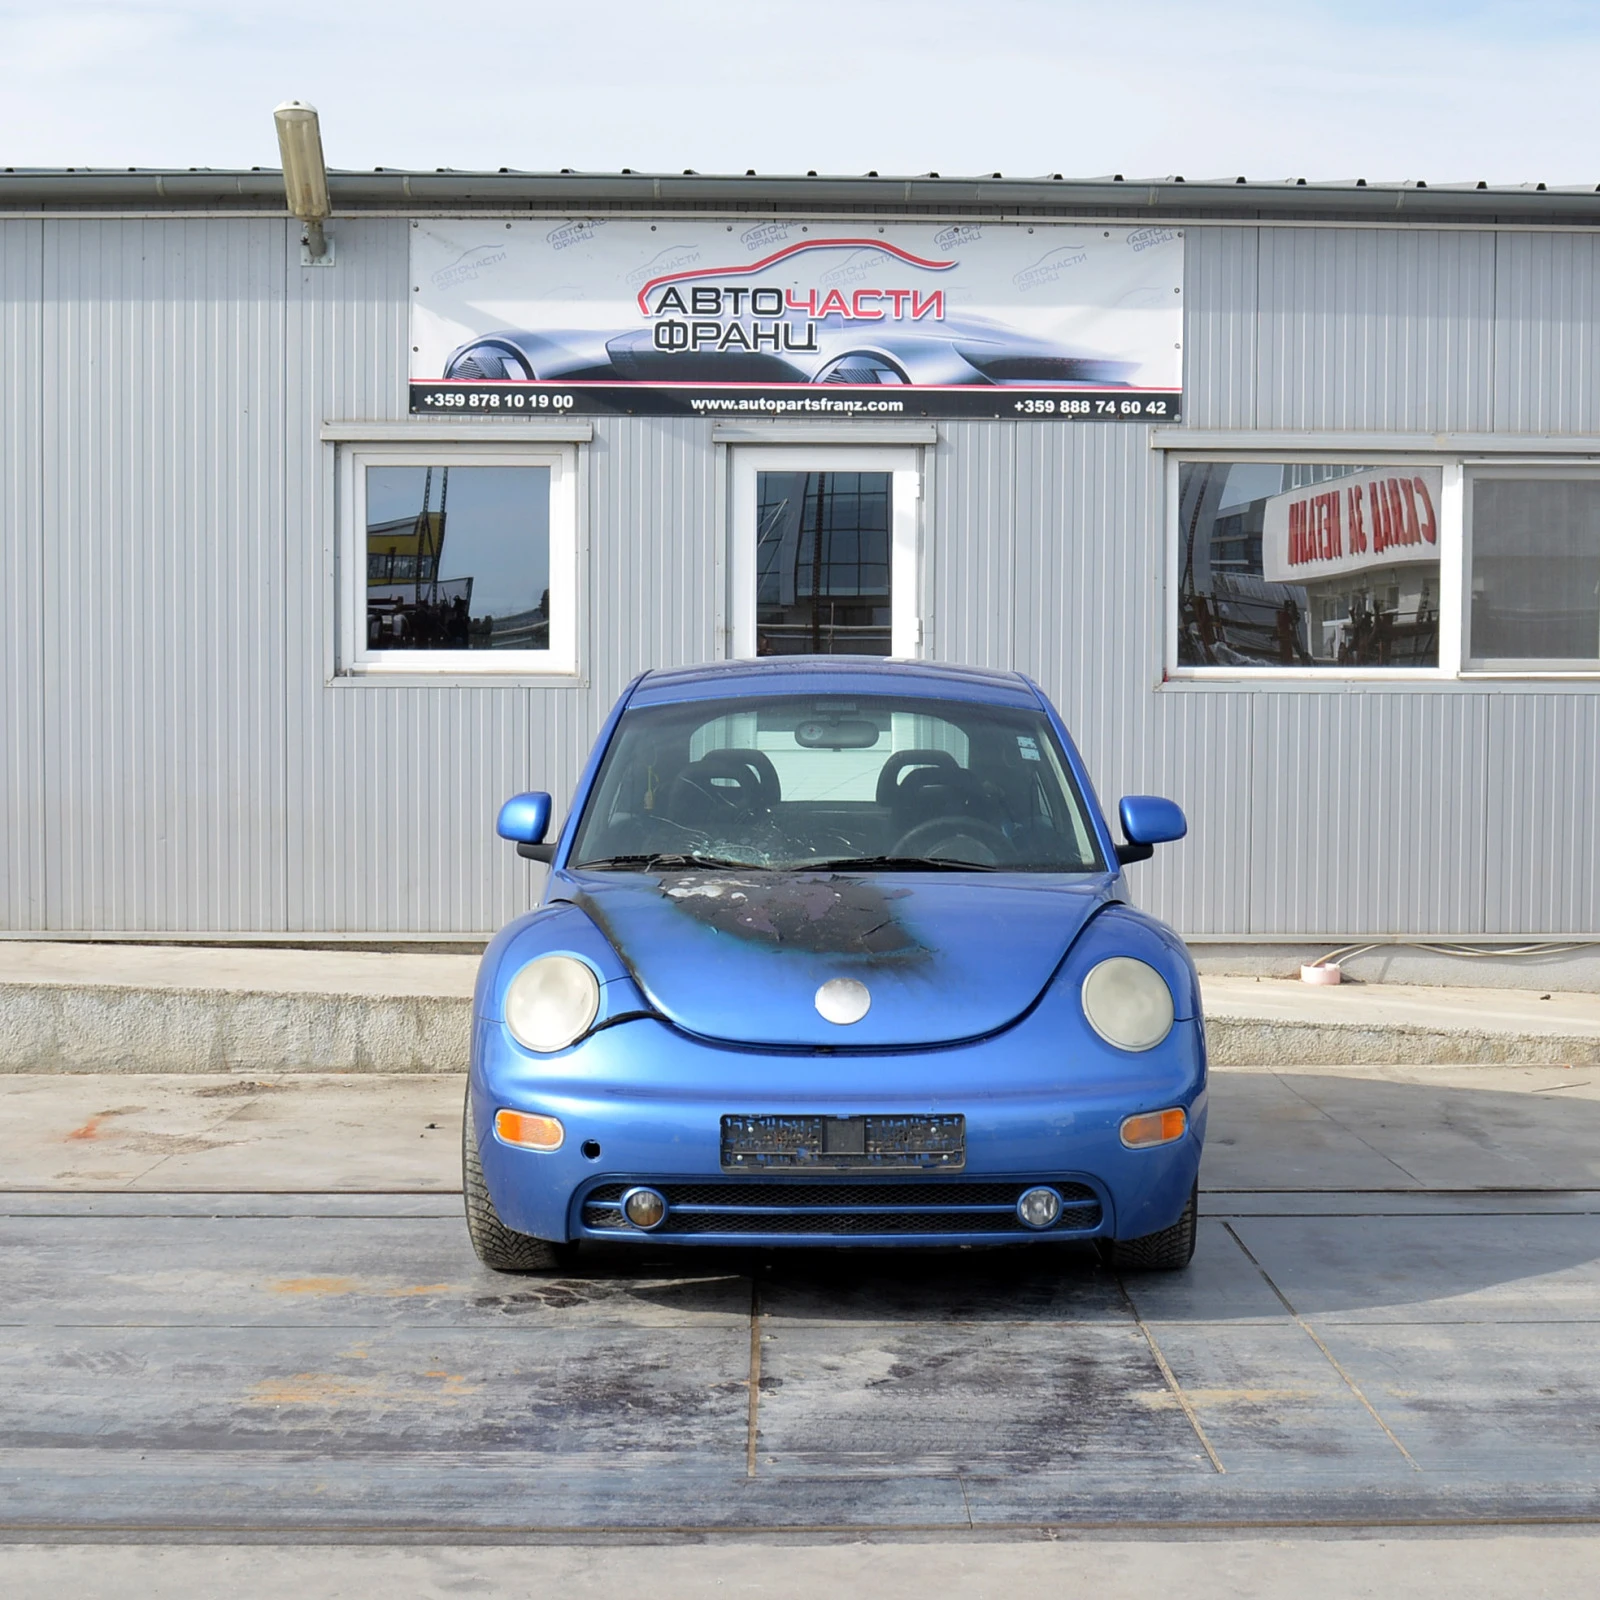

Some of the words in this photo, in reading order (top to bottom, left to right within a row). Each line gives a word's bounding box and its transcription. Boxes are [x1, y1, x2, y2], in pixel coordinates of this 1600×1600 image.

[553, 231, 594, 250] ФРАНЦ
[745, 221, 799, 243] АВТОЧА
[747, 231, 788, 251] ФРАНЦ
[940, 231, 982, 251] ФРАНЦ
[1133, 233, 1174, 252] ФРАНЦ
[436, 252, 507, 283] АВТОЧАСТИ
[630, 252, 701, 284] АВТОЧАСТИ
[1017, 253, 1088, 284] АВТОЧАСТИ
[1018, 272, 1060, 292] ФРАНЦ
[654, 286, 943, 318] АВТОЧАСТИ
[654, 319, 818, 351] ФРАНЦ
[424, 393, 465, 407] +359
[468, 393, 500, 407] 878
[504, 394, 525, 407] 10
[528, 394, 549, 408] 19
[552, 394, 574, 408] 00
[691, 397, 904, 413] www.autopartsfranz.com
[1014, 399, 1055, 413] +359
[1059, 400, 1091, 413] 888
[1095, 401, 1117, 414] 74
[1120, 401, 1141, 414] 60
[1145, 401, 1167, 415] 42
